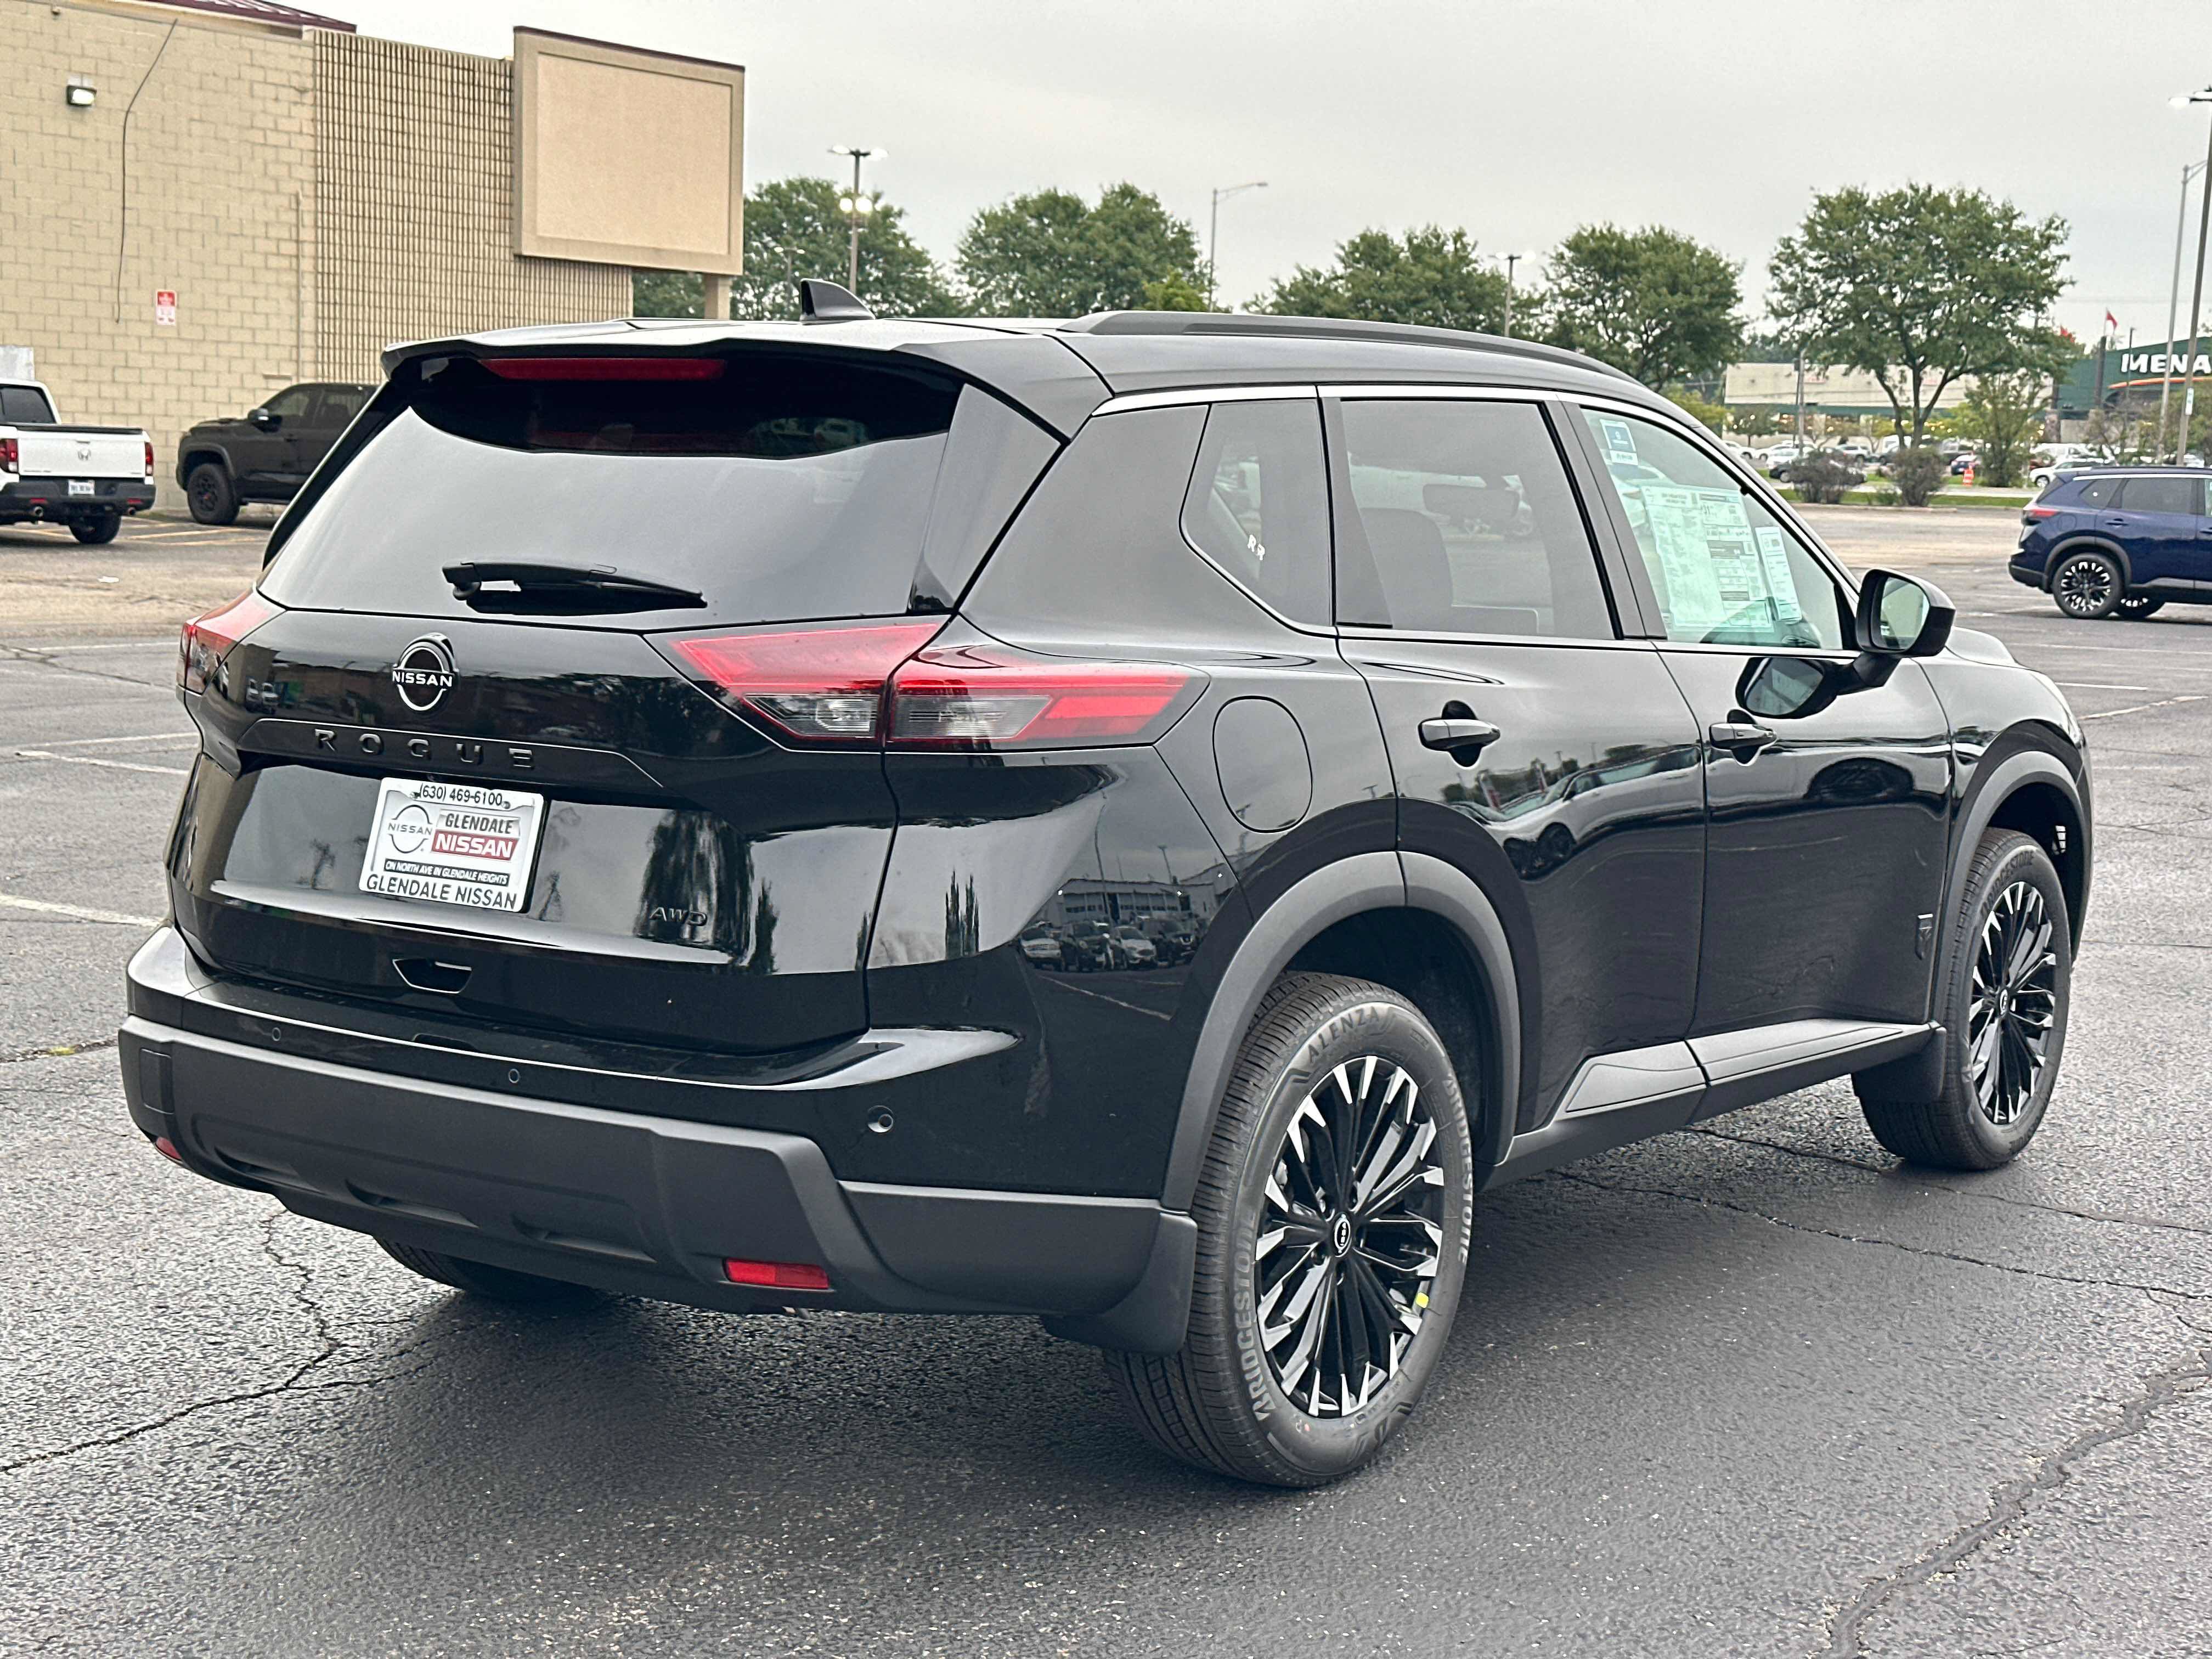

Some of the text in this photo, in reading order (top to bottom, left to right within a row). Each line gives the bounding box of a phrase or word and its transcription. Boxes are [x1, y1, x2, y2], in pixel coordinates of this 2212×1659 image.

[392, 671, 453, 687] NISSAN
[314, 729, 534, 769] ROGUE
[420, 783, 503, 806] (630) 469-6100
[388, 823, 432, 835] NISSAN
[445, 813, 514, 834] GLENDALE
[435, 833, 514, 857] NISSAN
[385, 860, 509, 884] ON NORTH AVE IN GLENDALE HEIGHTS
[367, 874, 517, 910] GLENDALE NISSAN
[650, 907, 707, 926] AWD
[1308, 1006, 1379, 1064] ALENZA
